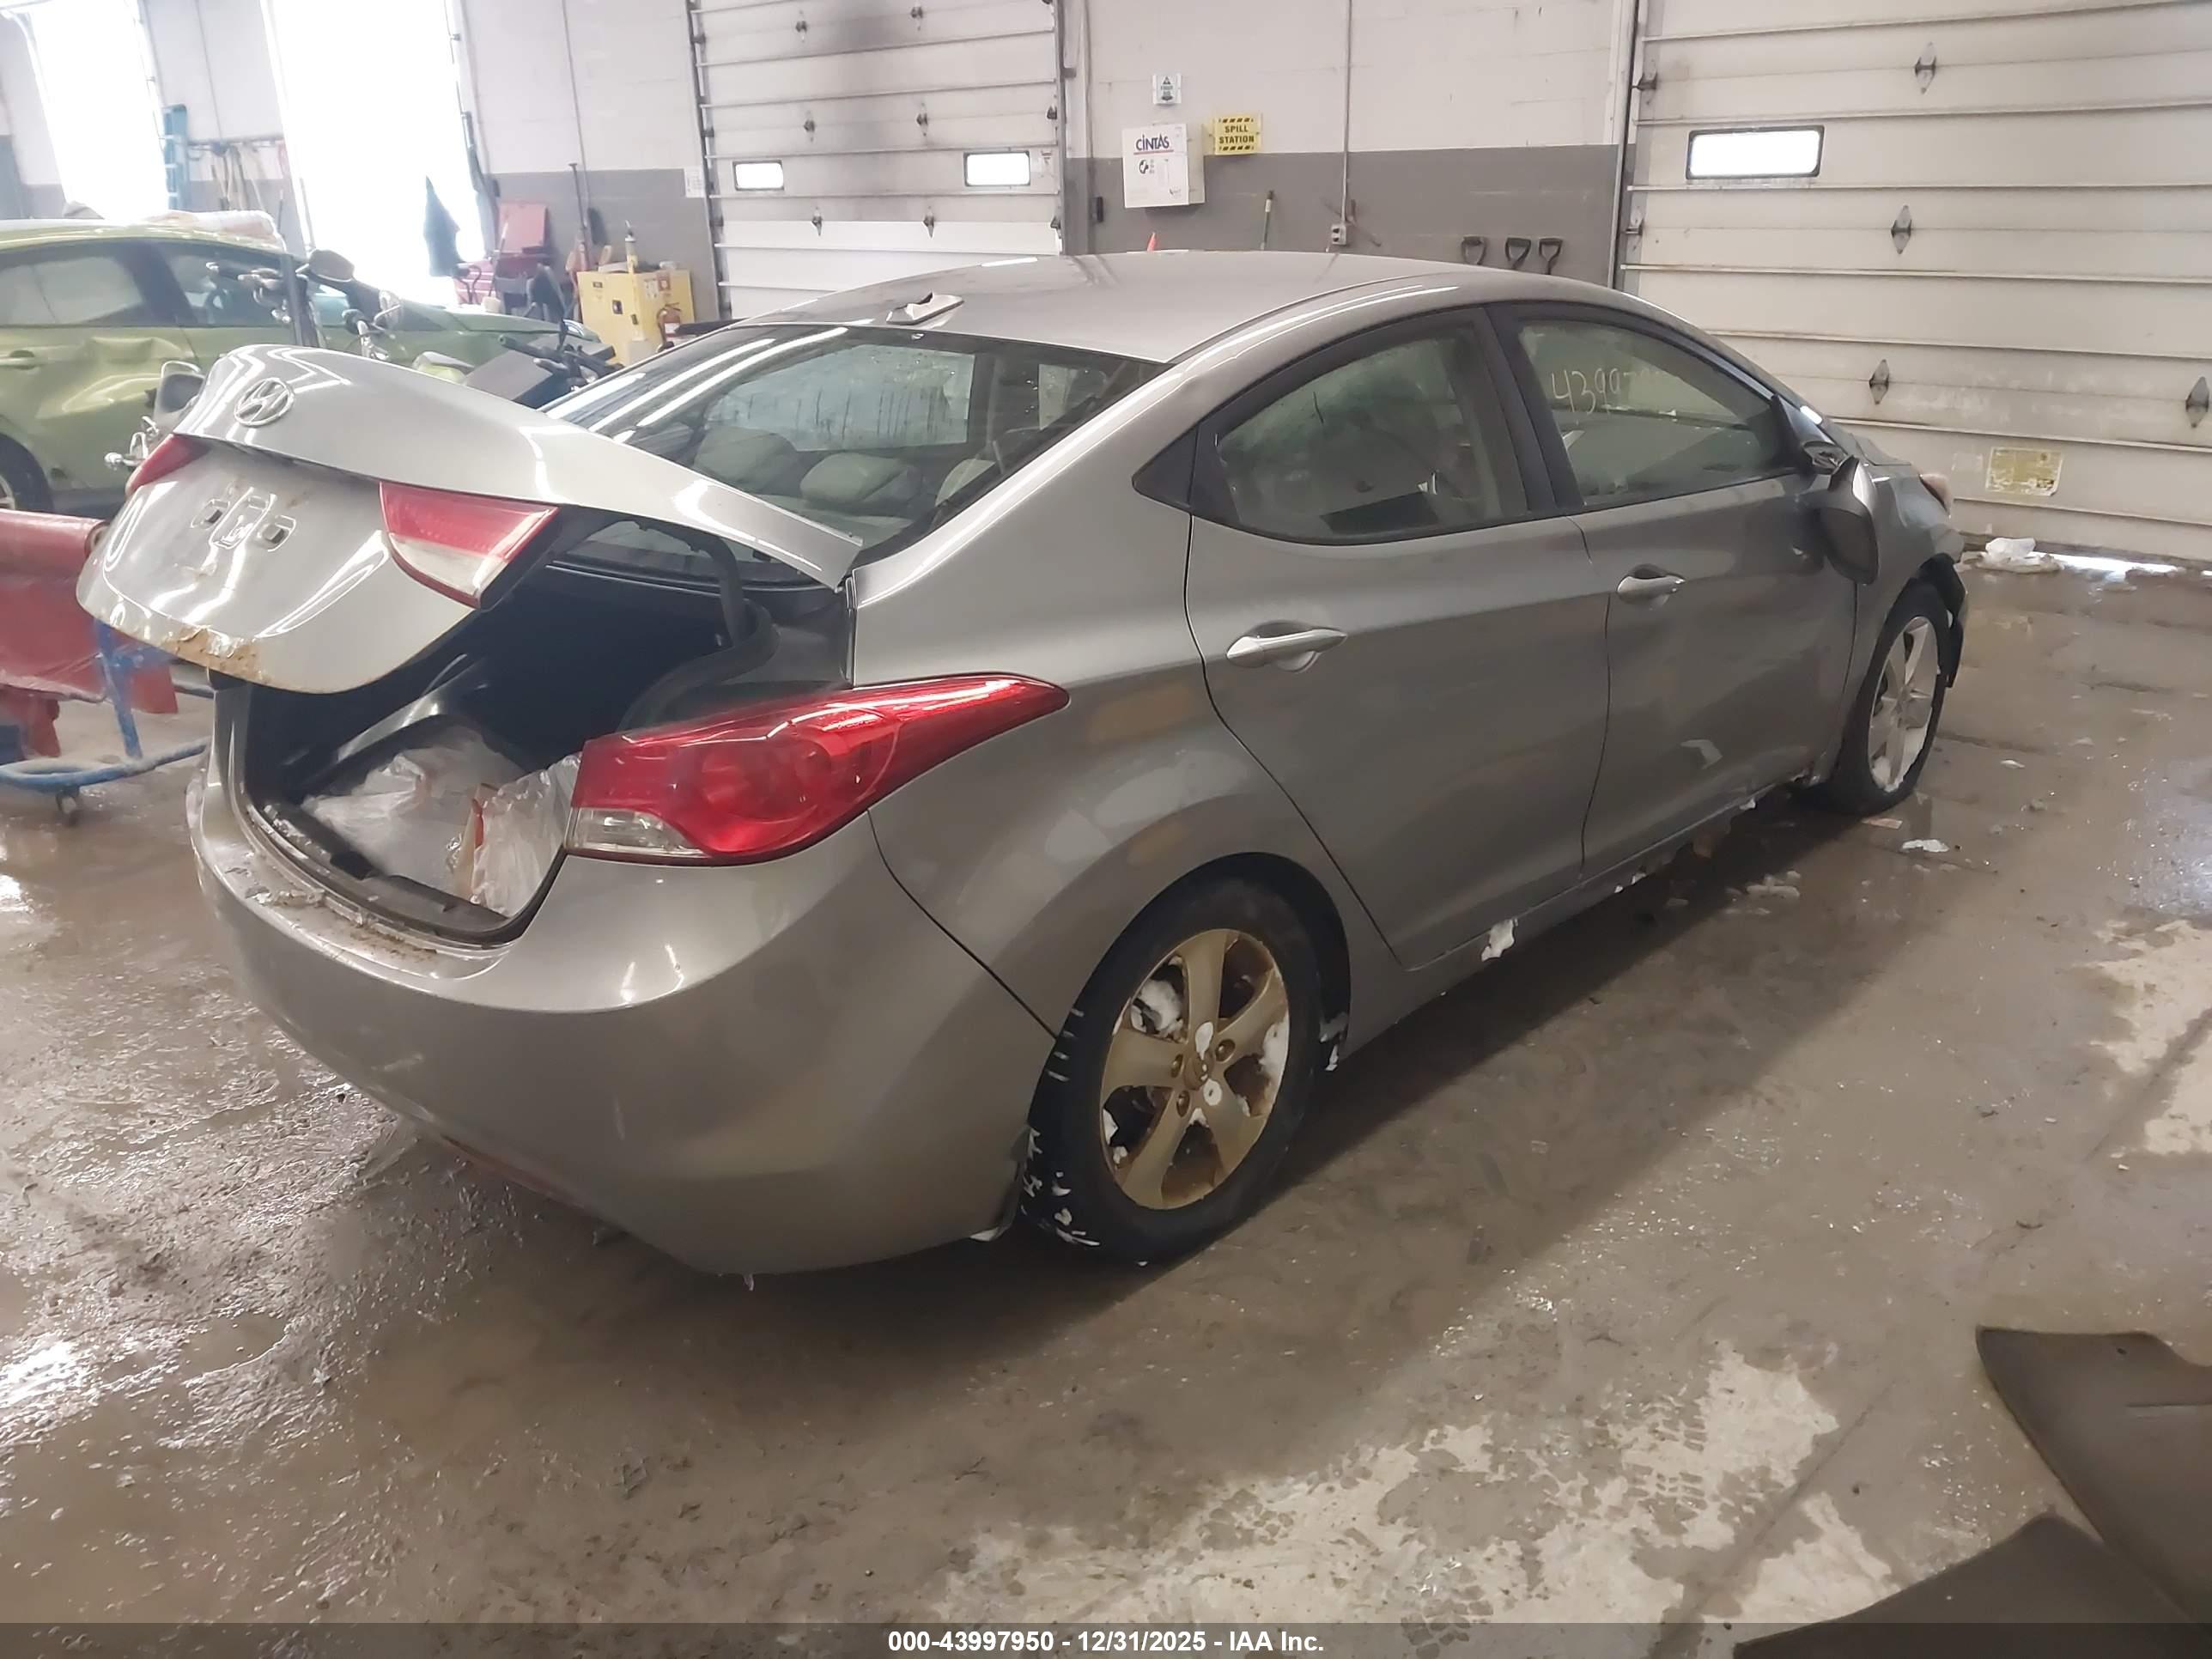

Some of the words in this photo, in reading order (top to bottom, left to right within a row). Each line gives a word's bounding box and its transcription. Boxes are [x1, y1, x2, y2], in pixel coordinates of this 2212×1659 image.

[1224, 125, 1249, 133] SPILL
[1135, 133, 1170, 151] CINTAS
[1218, 135, 1255, 144] STATION
